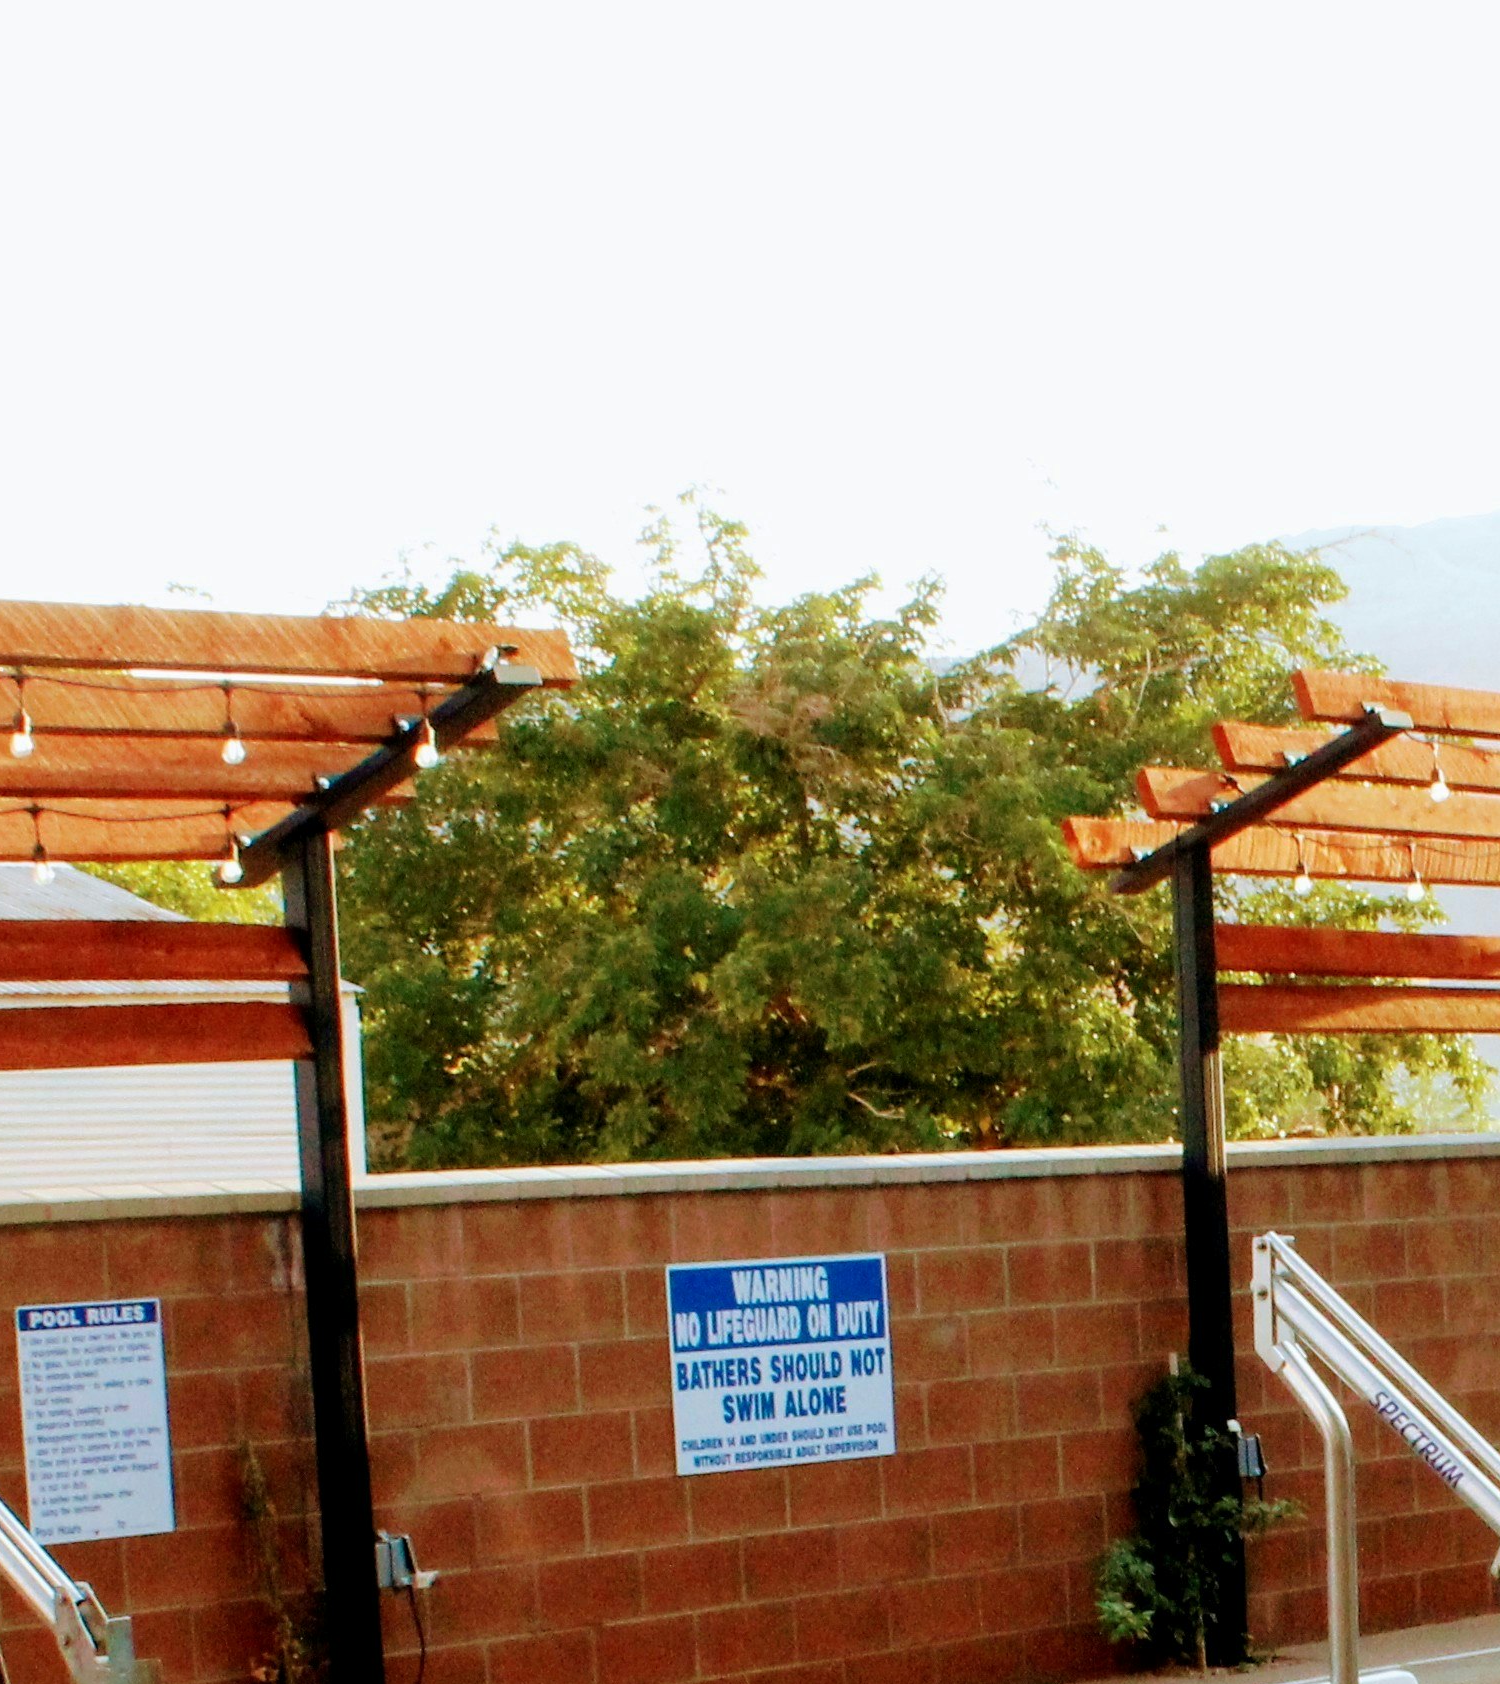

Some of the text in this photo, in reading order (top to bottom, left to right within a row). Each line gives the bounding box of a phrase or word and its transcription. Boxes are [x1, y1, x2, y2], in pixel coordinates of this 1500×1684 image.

[731, 1265, 829, 1305] WARNING
[29, 1305, 145, 1329] POOL RULES
[674, 1300, 880, 1348] NO LIFEGUARD ON DUTY
[676, 1347, 885, 1391] BATHERS SHOULD NOT
[722, 1385, 847, 1424] SWIM ALONE
[681, 1437, 723, 1451] CHILDREN
[740, 1434, 757, 1446] AND
[760, 1431, 788, 1445] UNDER
[792, 1427, 824, 1441] SHOULD
[828, 1425, 844, 1437] NOT
[847, 1423, 863, 1436] USE
[866, 1422, 888, 1434] POOL
[693, 1440, 879, 1468] WITHOUT RESPONSIBLE ADULT SUPERVISION
[1369, 1391, 1464, 1489] SPECTRUM
